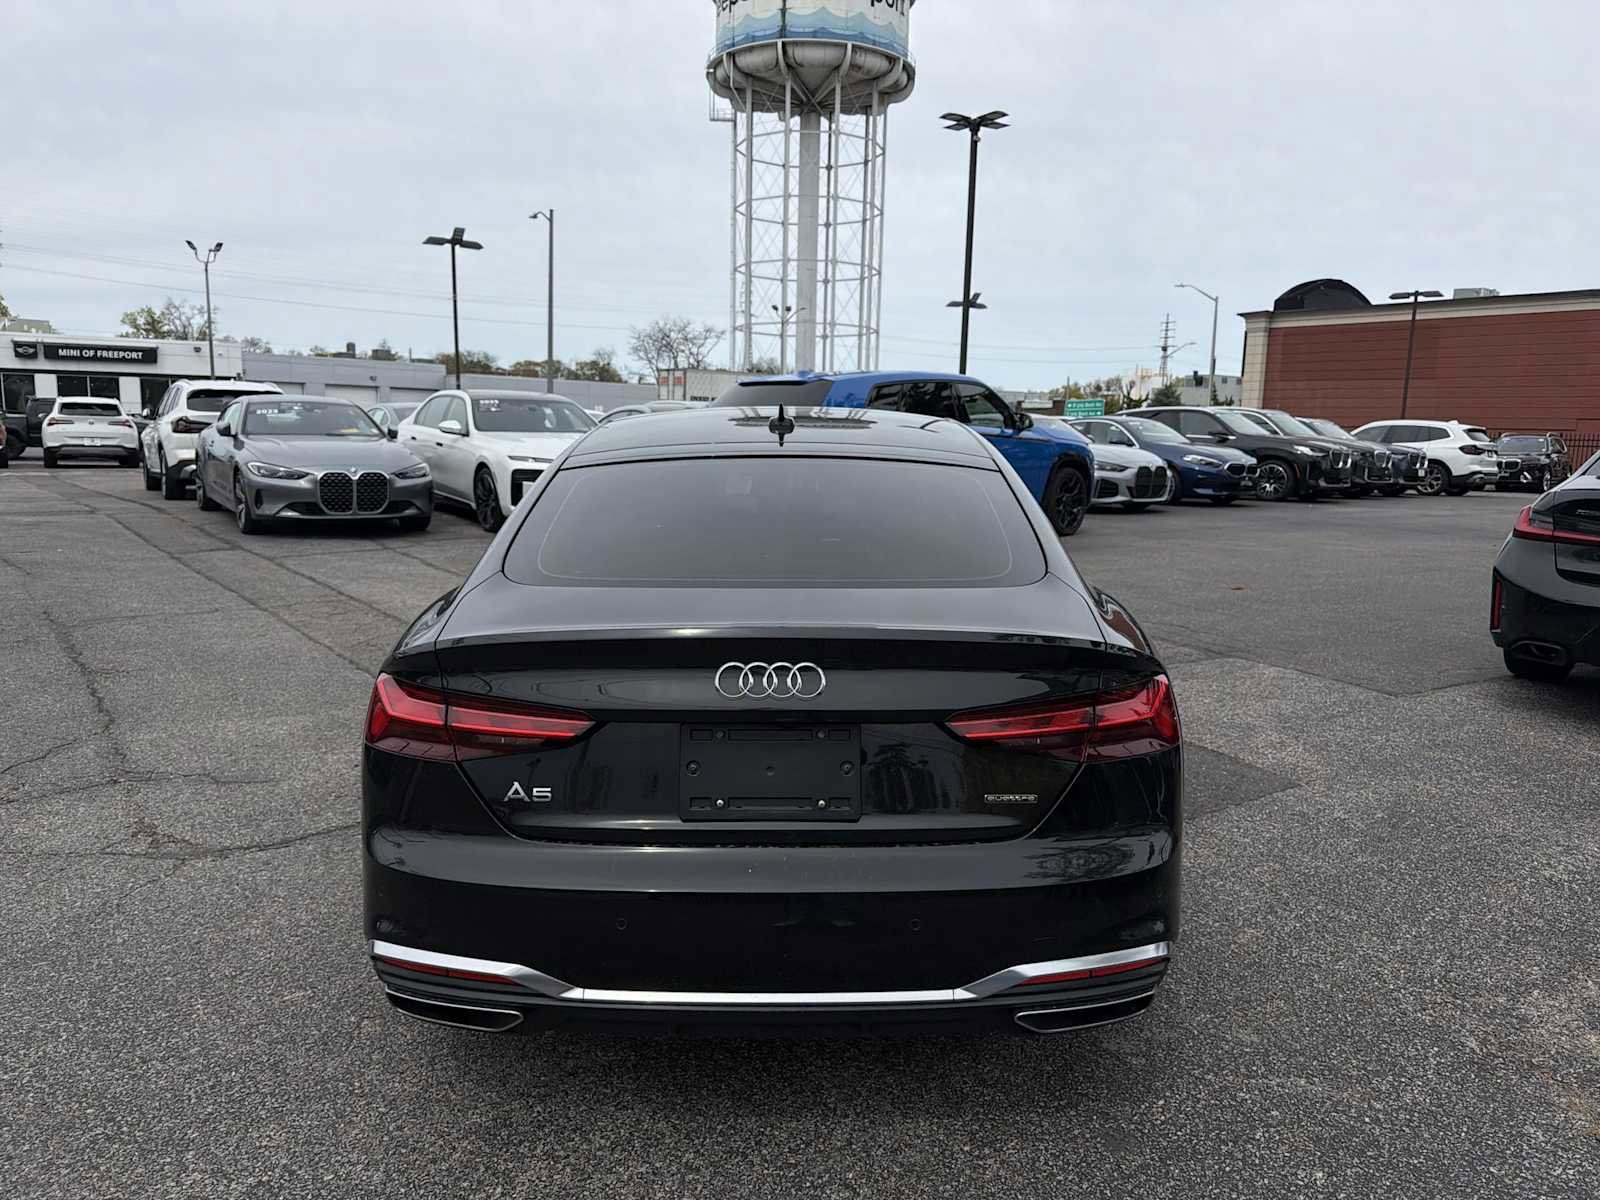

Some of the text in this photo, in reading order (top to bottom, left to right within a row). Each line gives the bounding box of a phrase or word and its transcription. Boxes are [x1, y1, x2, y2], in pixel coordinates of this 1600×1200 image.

[58, 348, 143, 359] MINI OF FREEPORT
[503, 780, 552, 802] A5
